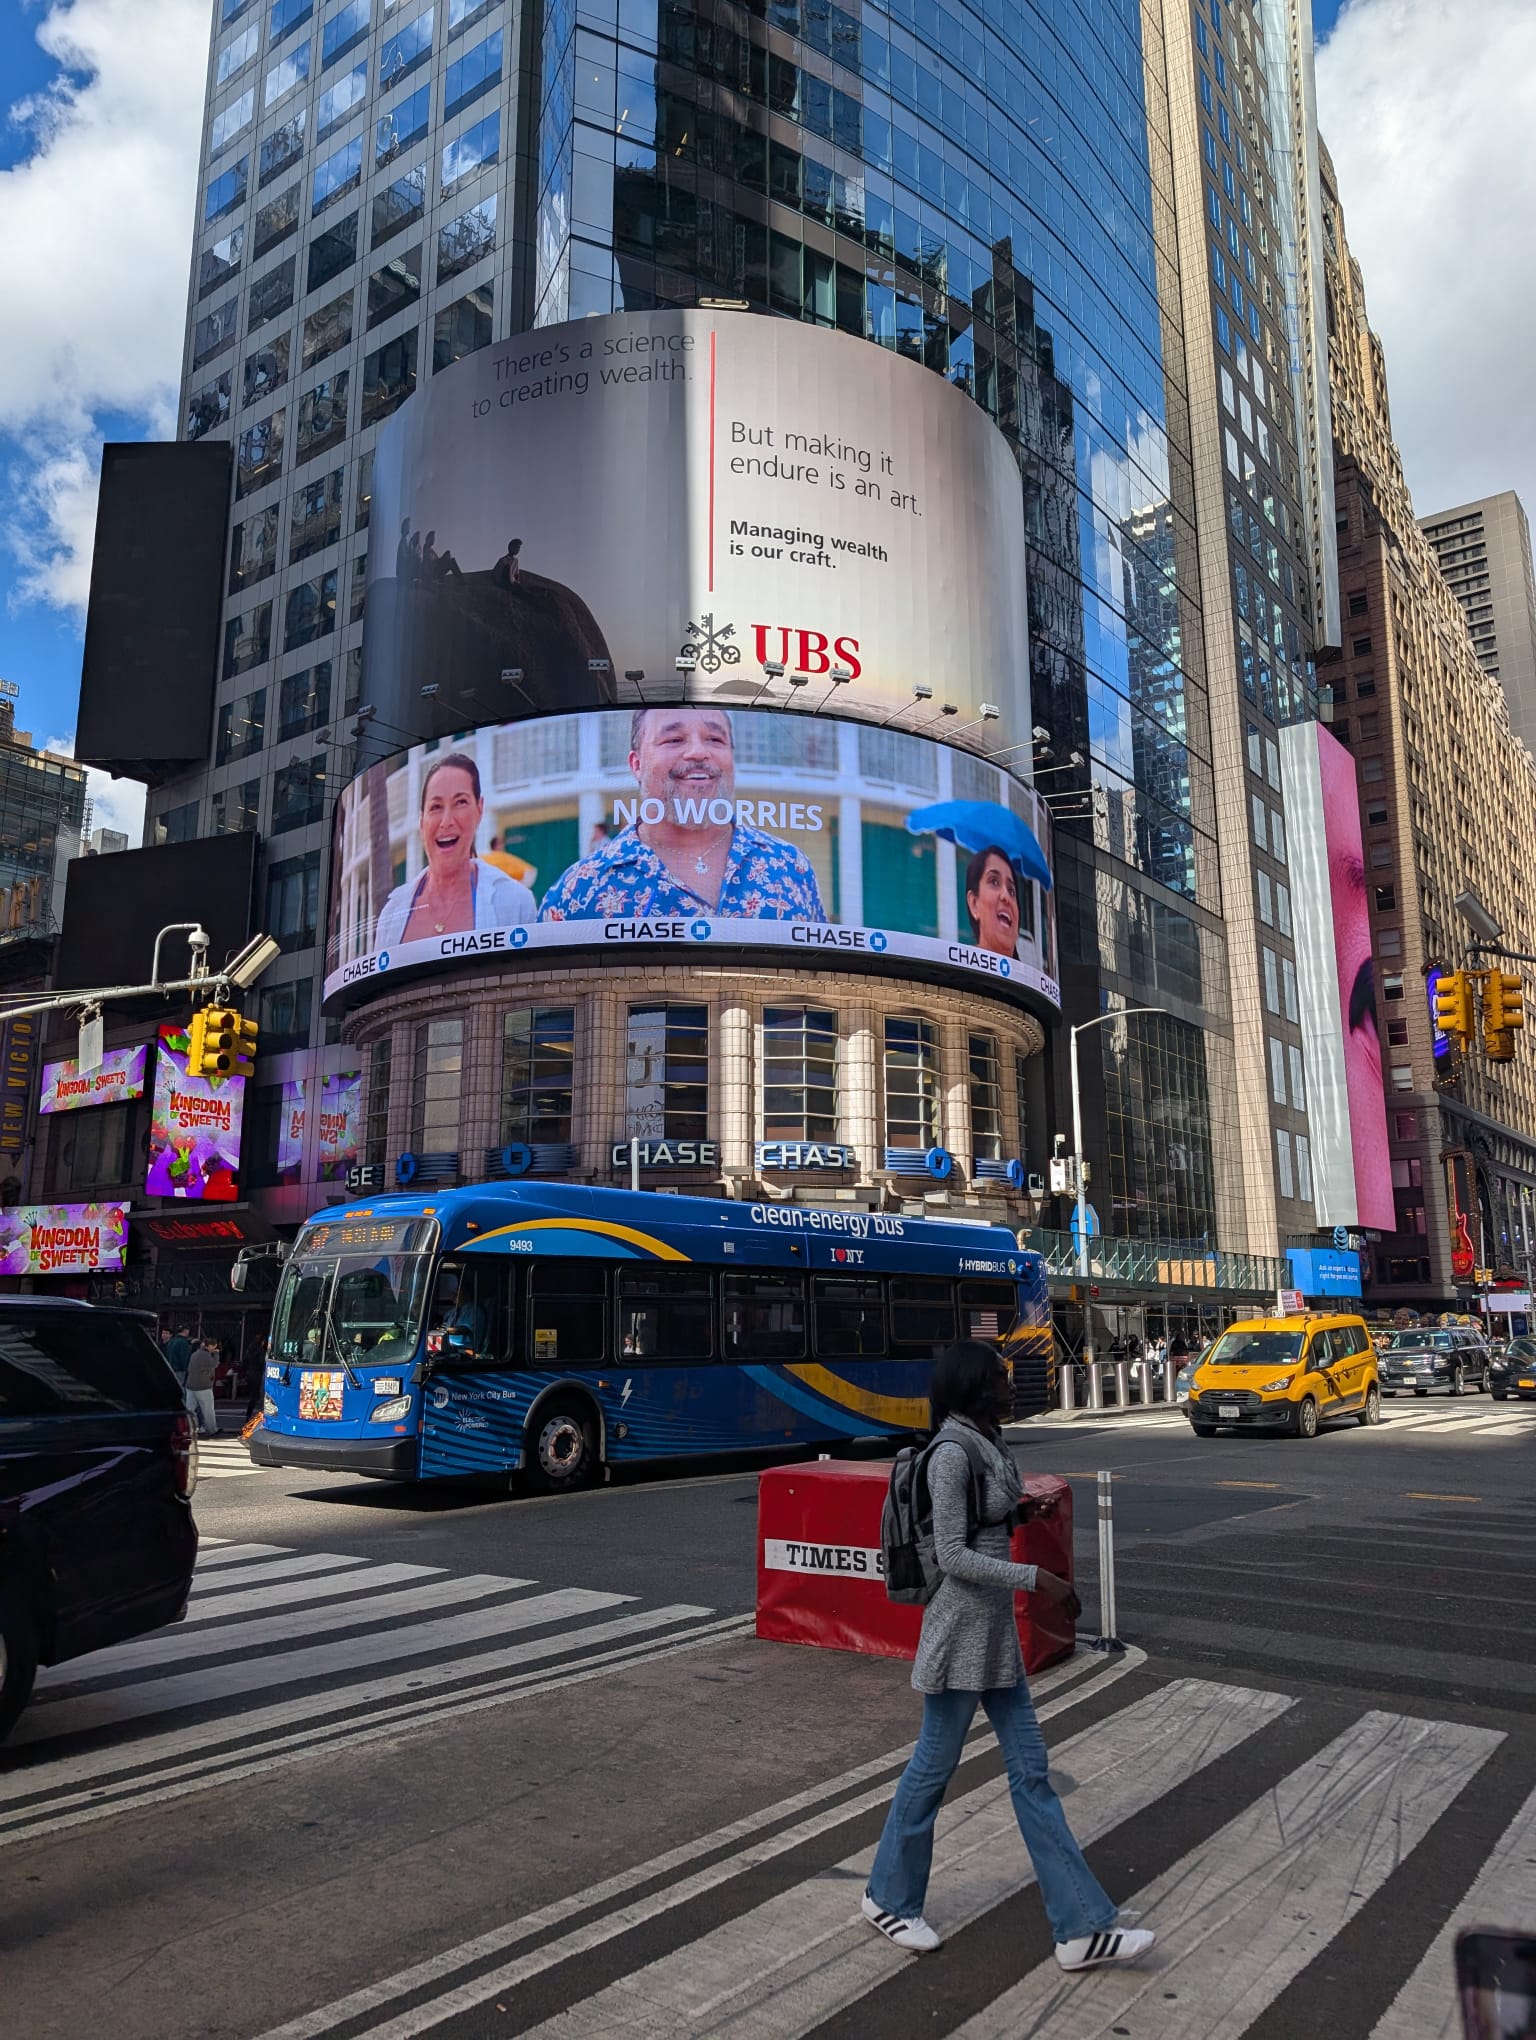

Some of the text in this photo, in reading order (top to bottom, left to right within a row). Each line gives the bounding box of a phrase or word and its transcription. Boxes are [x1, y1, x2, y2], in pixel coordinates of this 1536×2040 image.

[492, 331, 695, 381] There's a science
[471, 358, 693, 419] to creating wealth.
[731, 421, 894, 476] But making it
[730, 455, 923, 517] endure is an art.
[729, 539, 837, 569] is our craft.
[730, 520, 888, 562] Managing wealth
[750, 623, 862, 680] UBS
[613, 798, 823, 832] NO WORRIES
[441, 931, 505, 955] CHASE
[604, 922, 685, 940] CHASE
[791, 926, 865, 948] CHASE
[343, 956, 377, 983] CHASE
[948, 946, 997, 972] CHASE
[2, 1012, 33, 1148] NEW VICTO
[56, 1077, 91, 1099] KINGDOM
[95, 1071, 126, 1092] SWEETS
[170, 1091, 231, 1117] KINGDOM
[178, 1111, 231, 1131] SWEETS
[612, 1142, 716, 1167] CHASE
[759, 1143, 856, 1168] CHASE
[149, 1220, 245, 1239] Subway
[751, 1203, 905, 1238] clean-energy bus
[30, 1225, 100, 1250] KINGDOM
[510, 1239, 533, 1252] 9493
[30, 1249, 99, 1270] OF SWEETS
[451, 1390, 516, 1401] New York City Bus
[786, 1543, 867, 1573] TIMES
